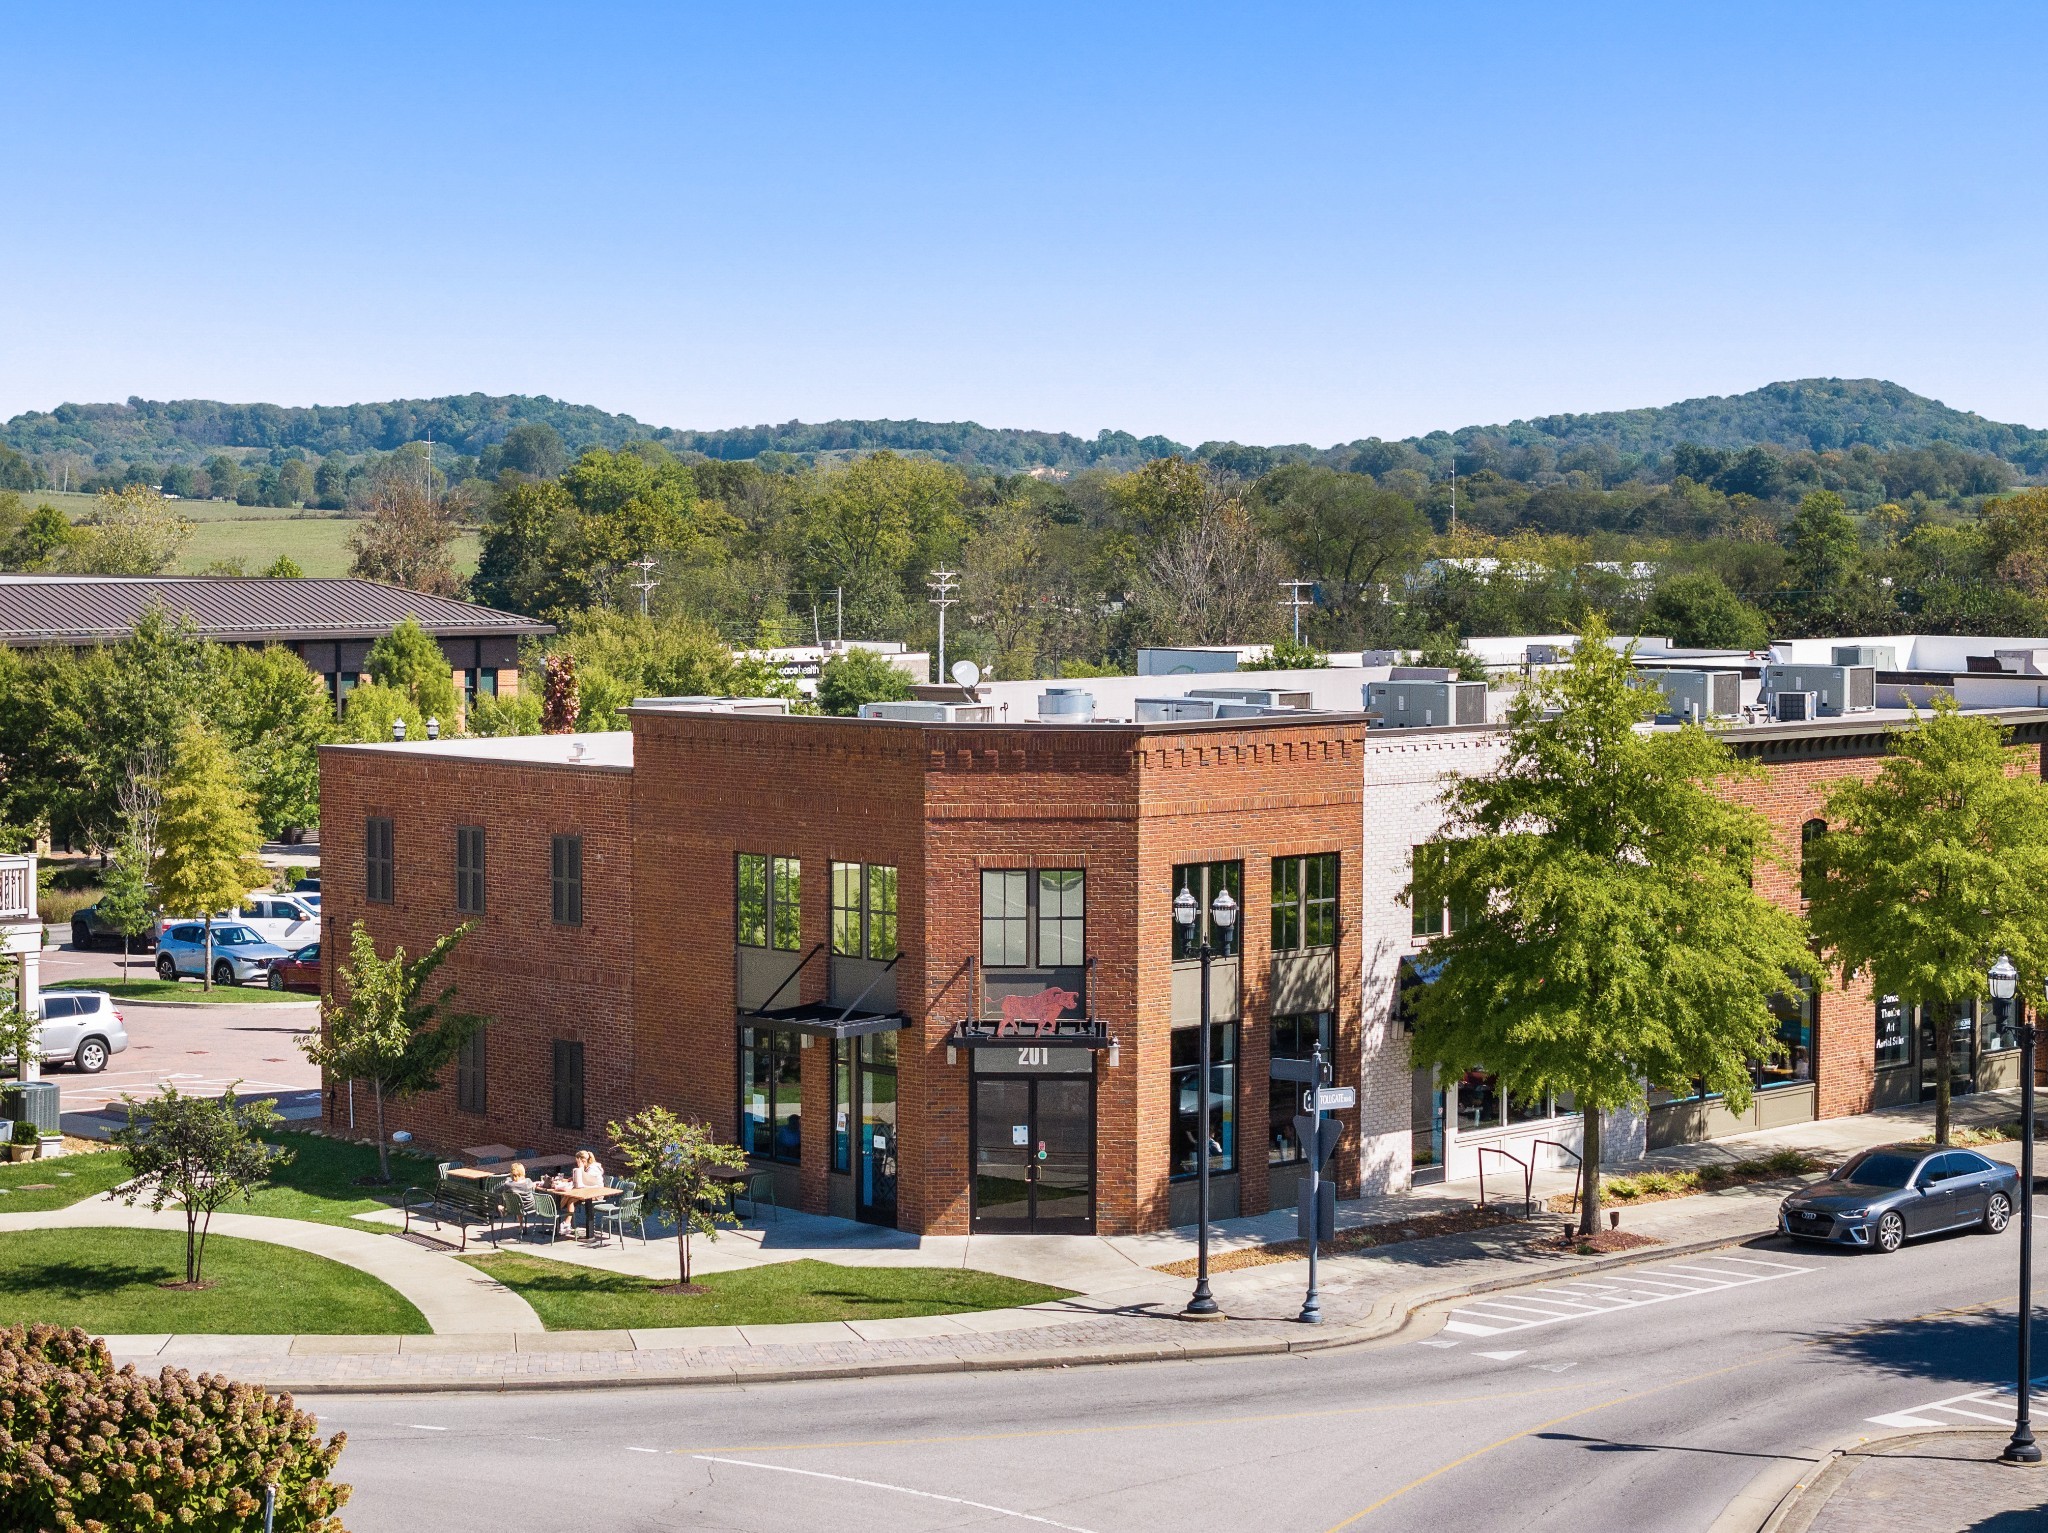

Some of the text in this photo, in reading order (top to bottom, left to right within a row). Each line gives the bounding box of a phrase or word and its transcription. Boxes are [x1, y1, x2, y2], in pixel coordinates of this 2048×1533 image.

[1886, 1022, 1895, 1032] Art
[1018, 1047, 1048, 1065] 201
[1319, 1093, 1344, 1105] TOLLGATE
